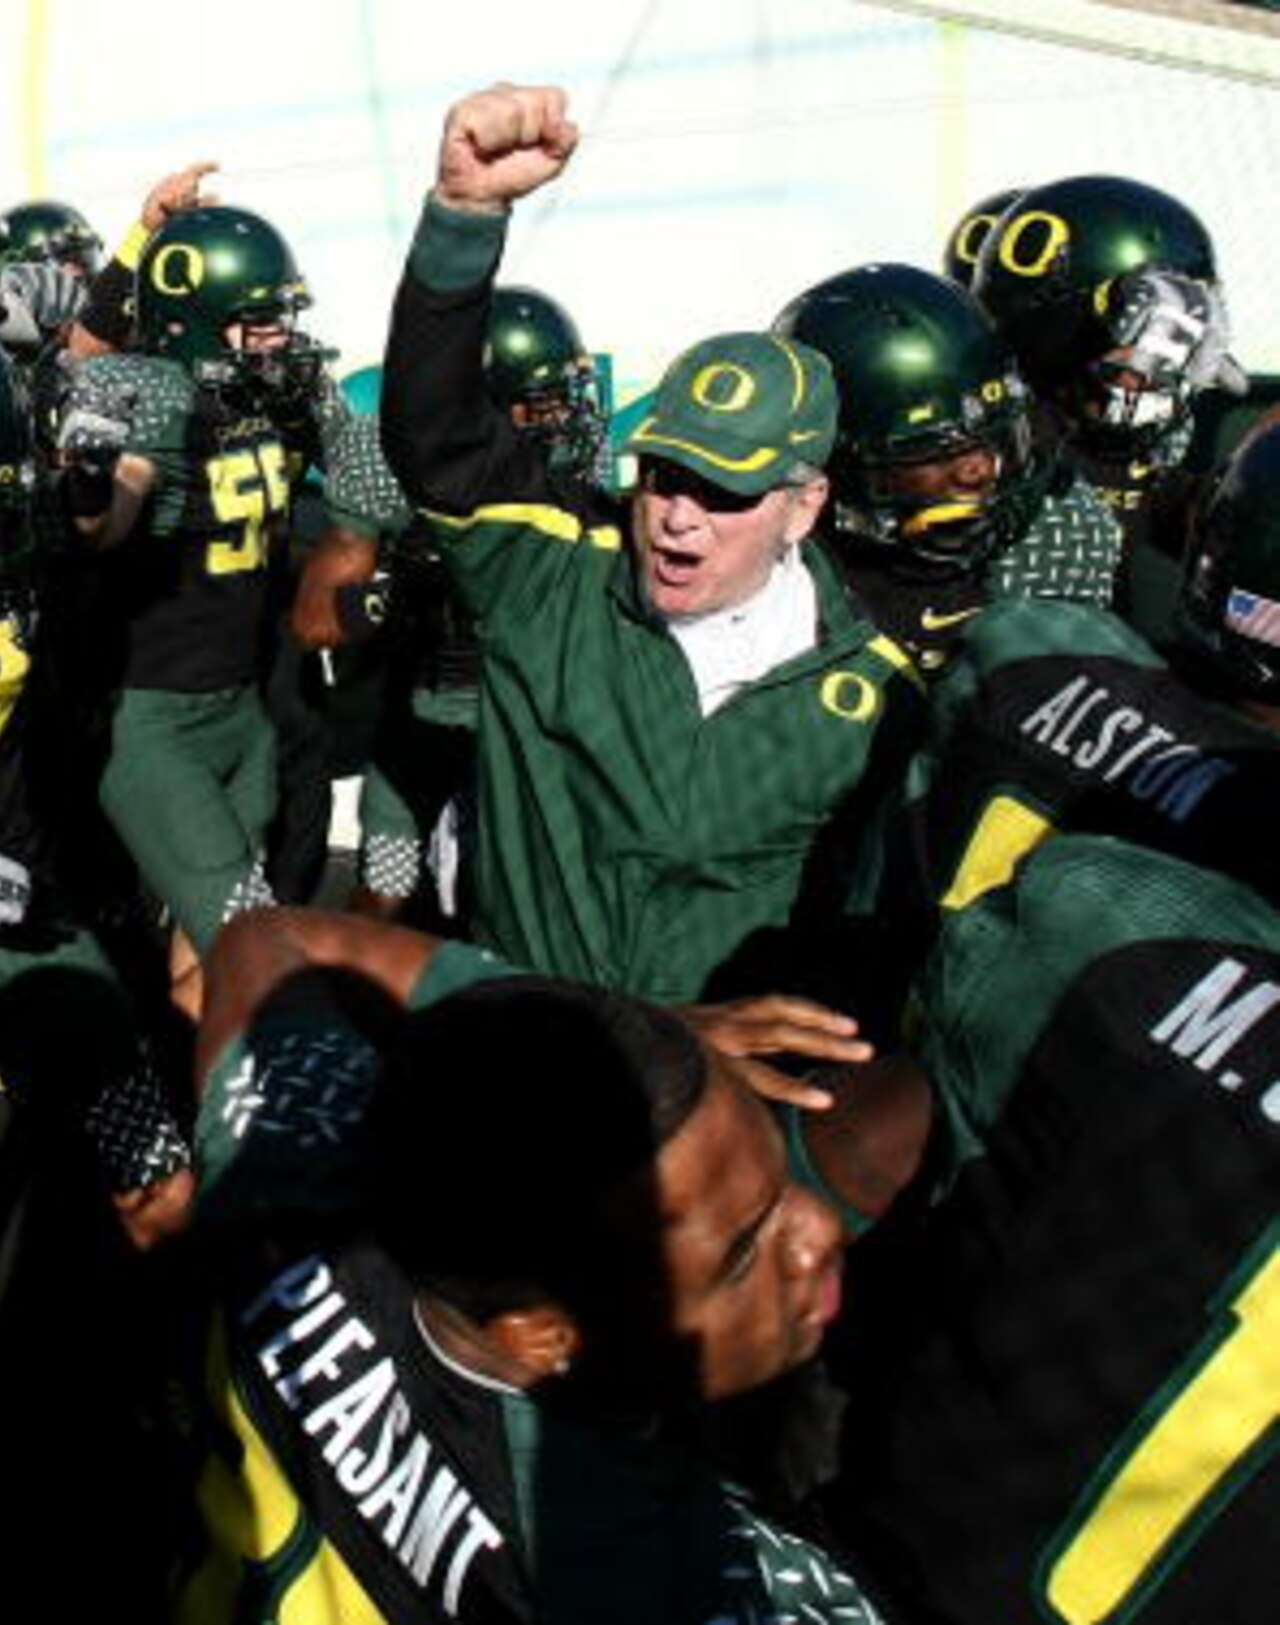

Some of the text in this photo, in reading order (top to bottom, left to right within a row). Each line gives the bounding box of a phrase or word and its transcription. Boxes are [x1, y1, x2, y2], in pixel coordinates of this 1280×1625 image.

[691, 362, 756, 412] O
[821, 671, 878, 723] O
[1020, 675, 1238, 822] ALSTON
[239, 1252, 506, 1618] PLEASANT
